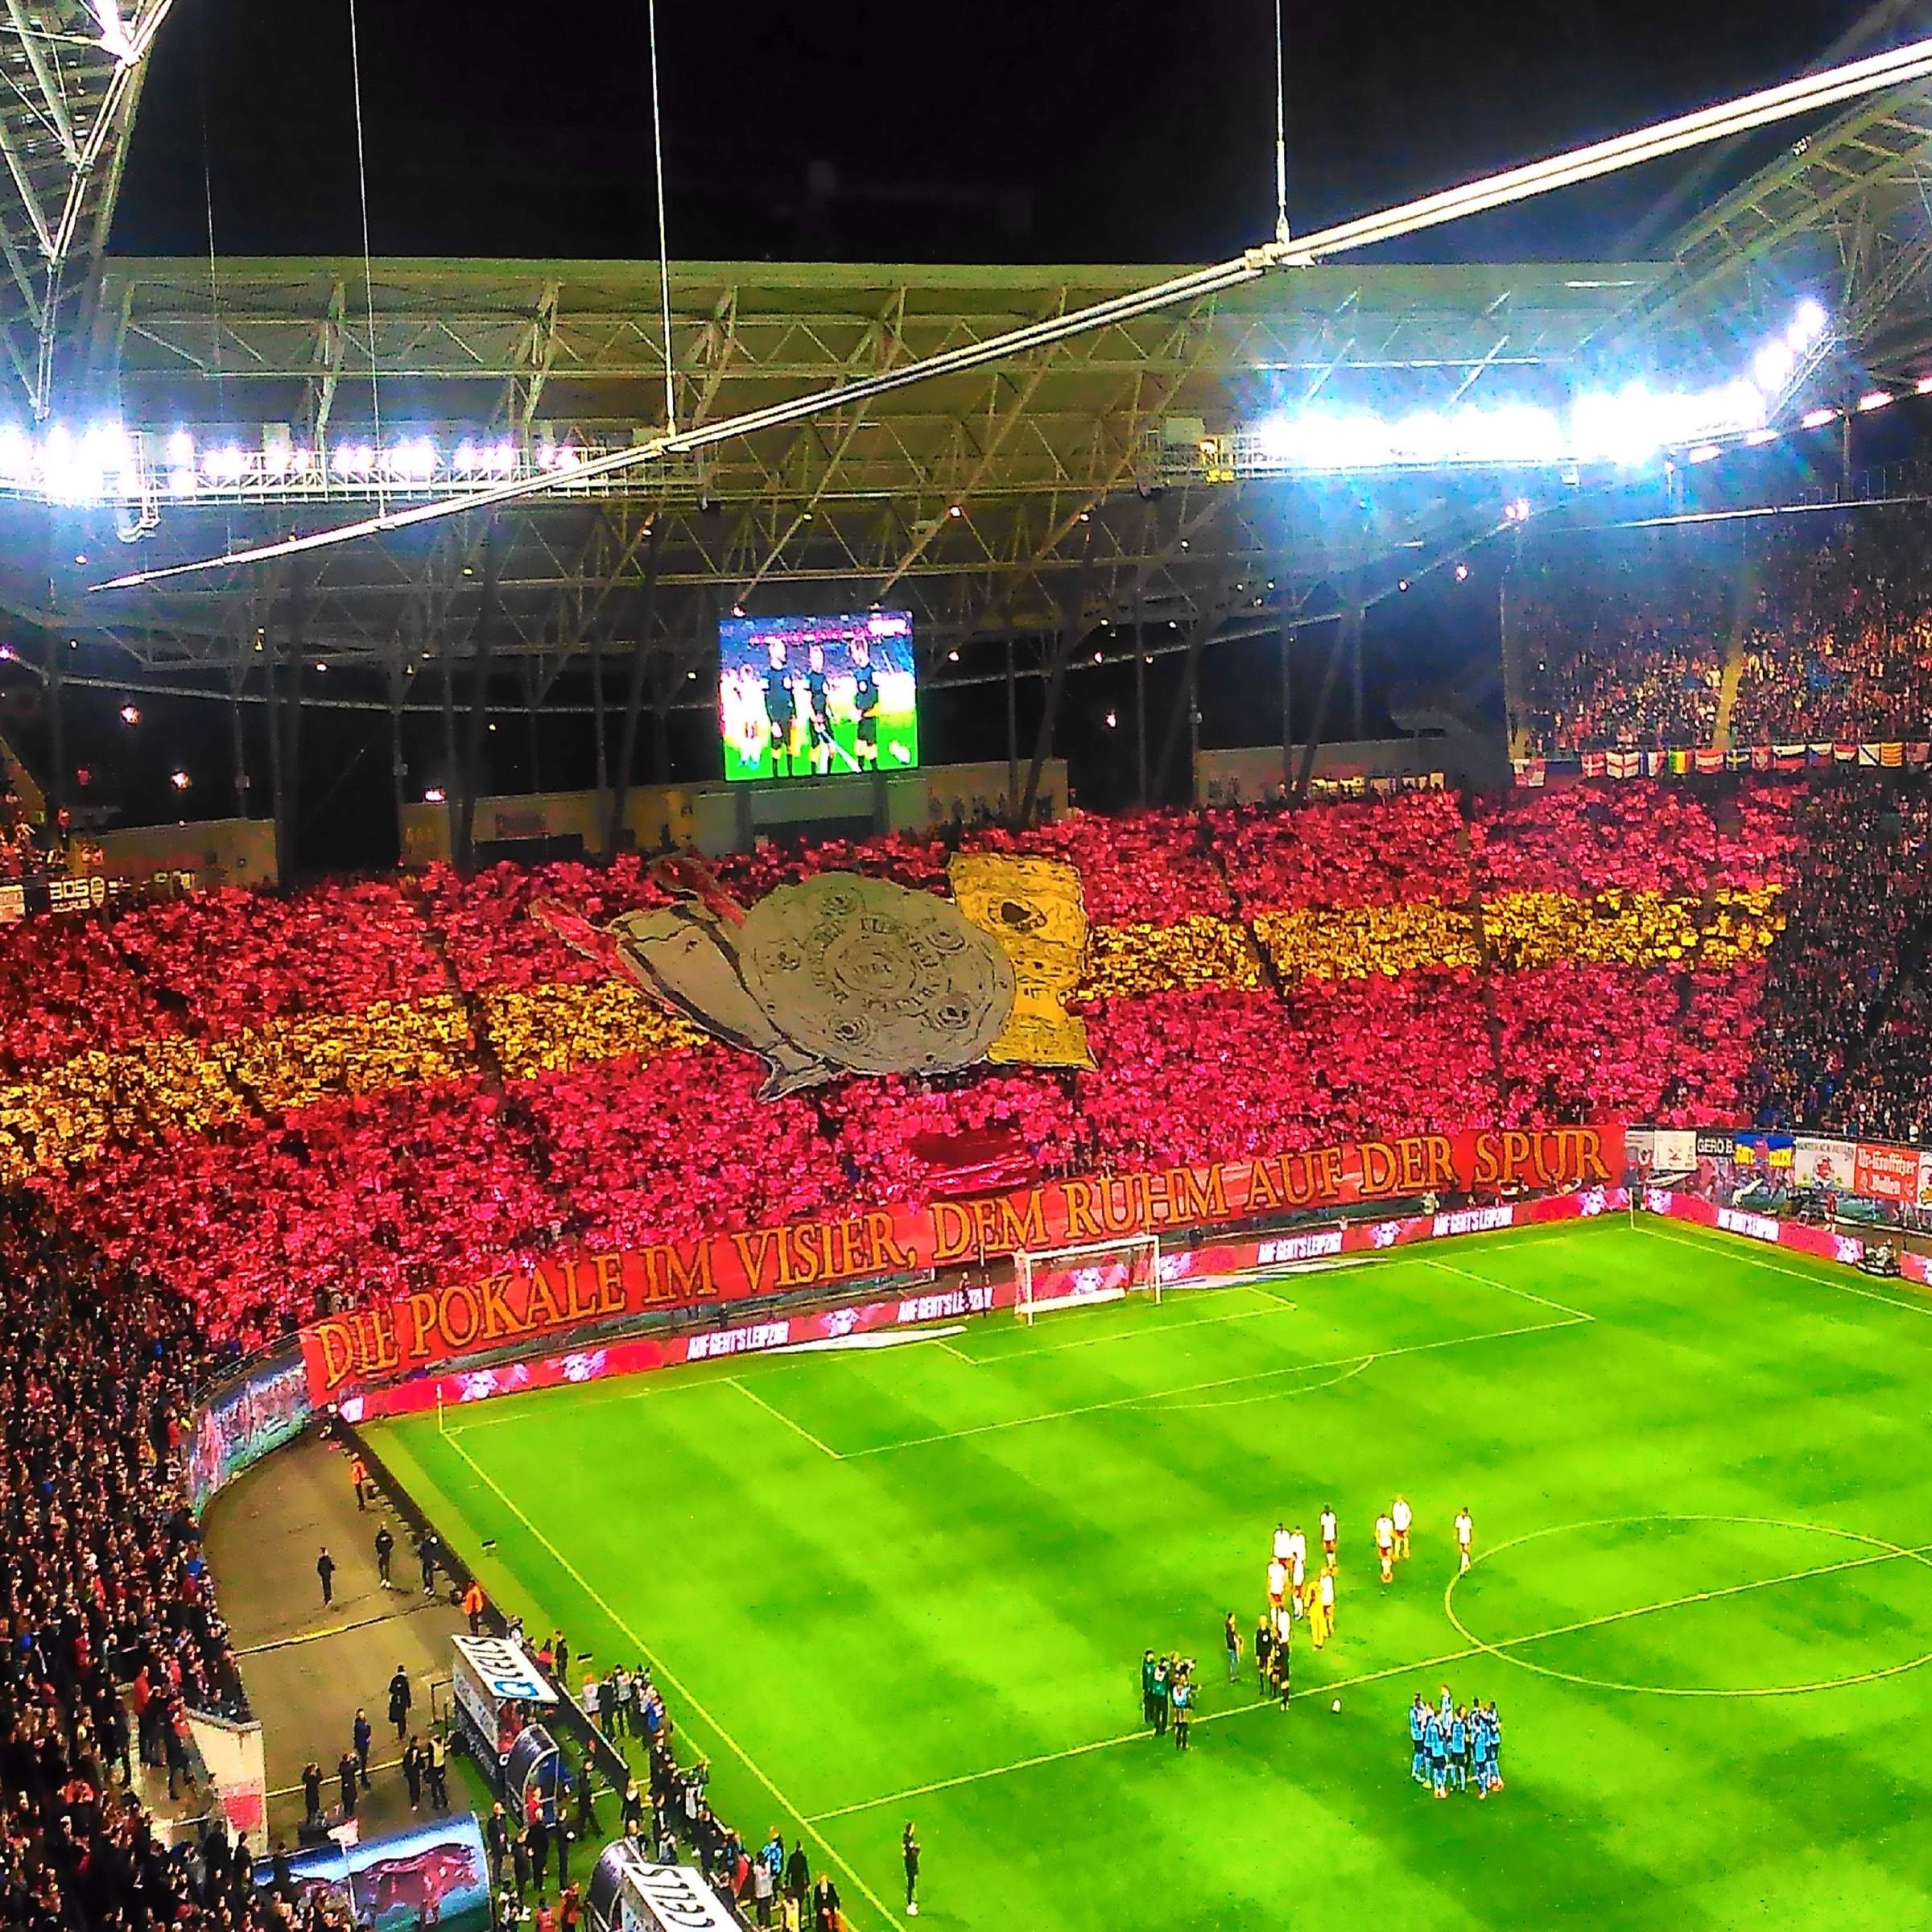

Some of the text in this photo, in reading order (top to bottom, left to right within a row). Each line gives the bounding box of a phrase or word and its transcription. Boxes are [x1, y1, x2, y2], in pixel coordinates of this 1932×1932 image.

[317, 1309, 399, 1389] DIE
[406, 1253, 625, 1357] POKALE
[640, 1236, 717, 1304] IM
[730, 1212, 917, 1290] VISIER,
[929, 1188, 1051, 1260] DEM
[1061, 1163, 1230, 1238] RUHM
[1245, 1147, 1343, 1211] AUF
[1357, 1136, 1459, 1193] DER
[1475, 1129, 1611, 1183] SPUR
[897, 1298, 919, 1323] AUF
[687, 1333, 709, 1360] AUF
